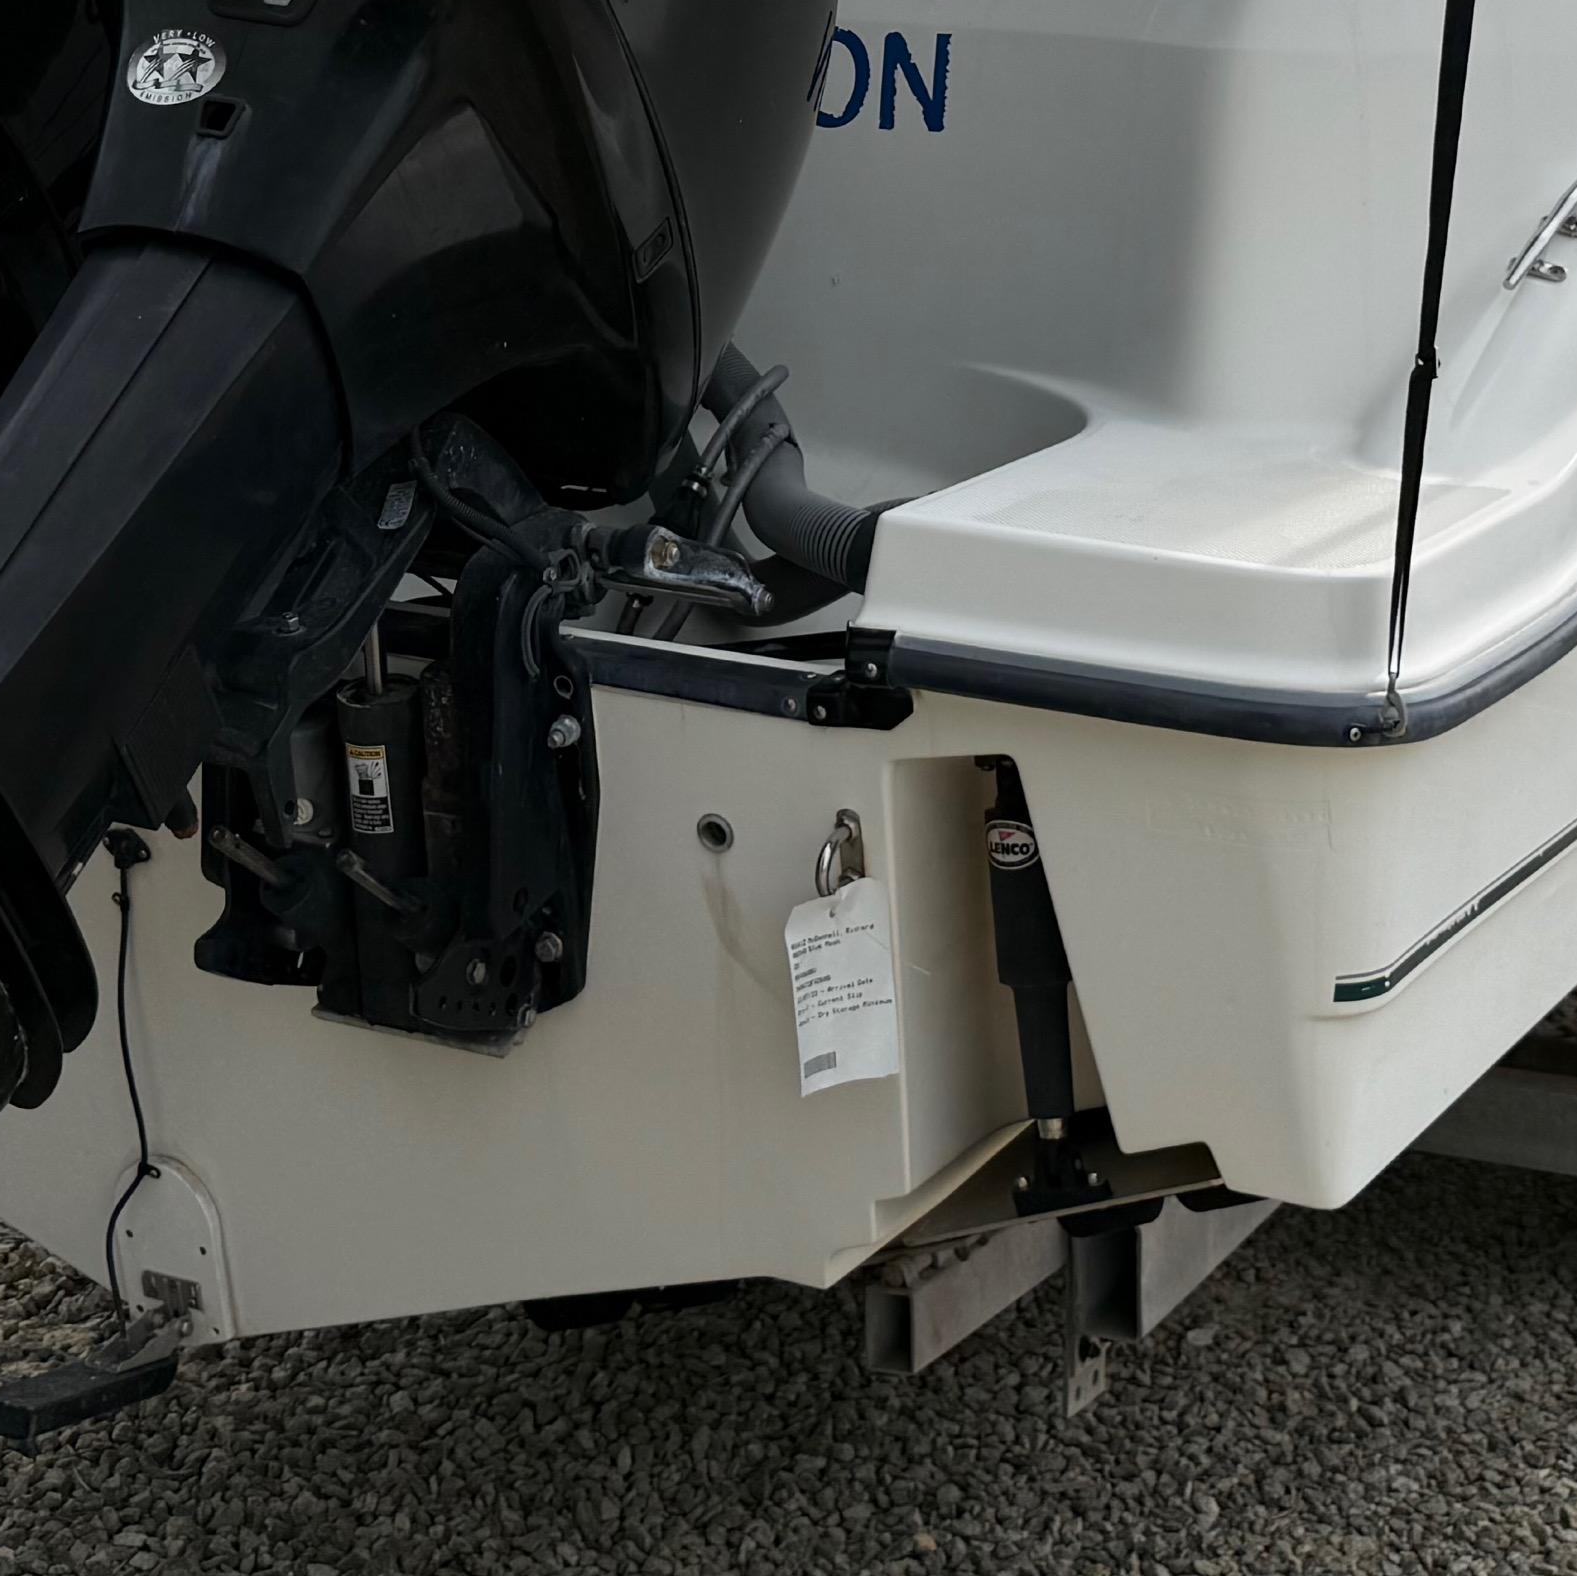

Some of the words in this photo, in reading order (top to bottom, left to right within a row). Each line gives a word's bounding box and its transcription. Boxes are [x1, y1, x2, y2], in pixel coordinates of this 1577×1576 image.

[153, 29, 183, 44] VERY
[192, 32, 216, 48] LOW
[990, 841, 1030, 856] LENCO
